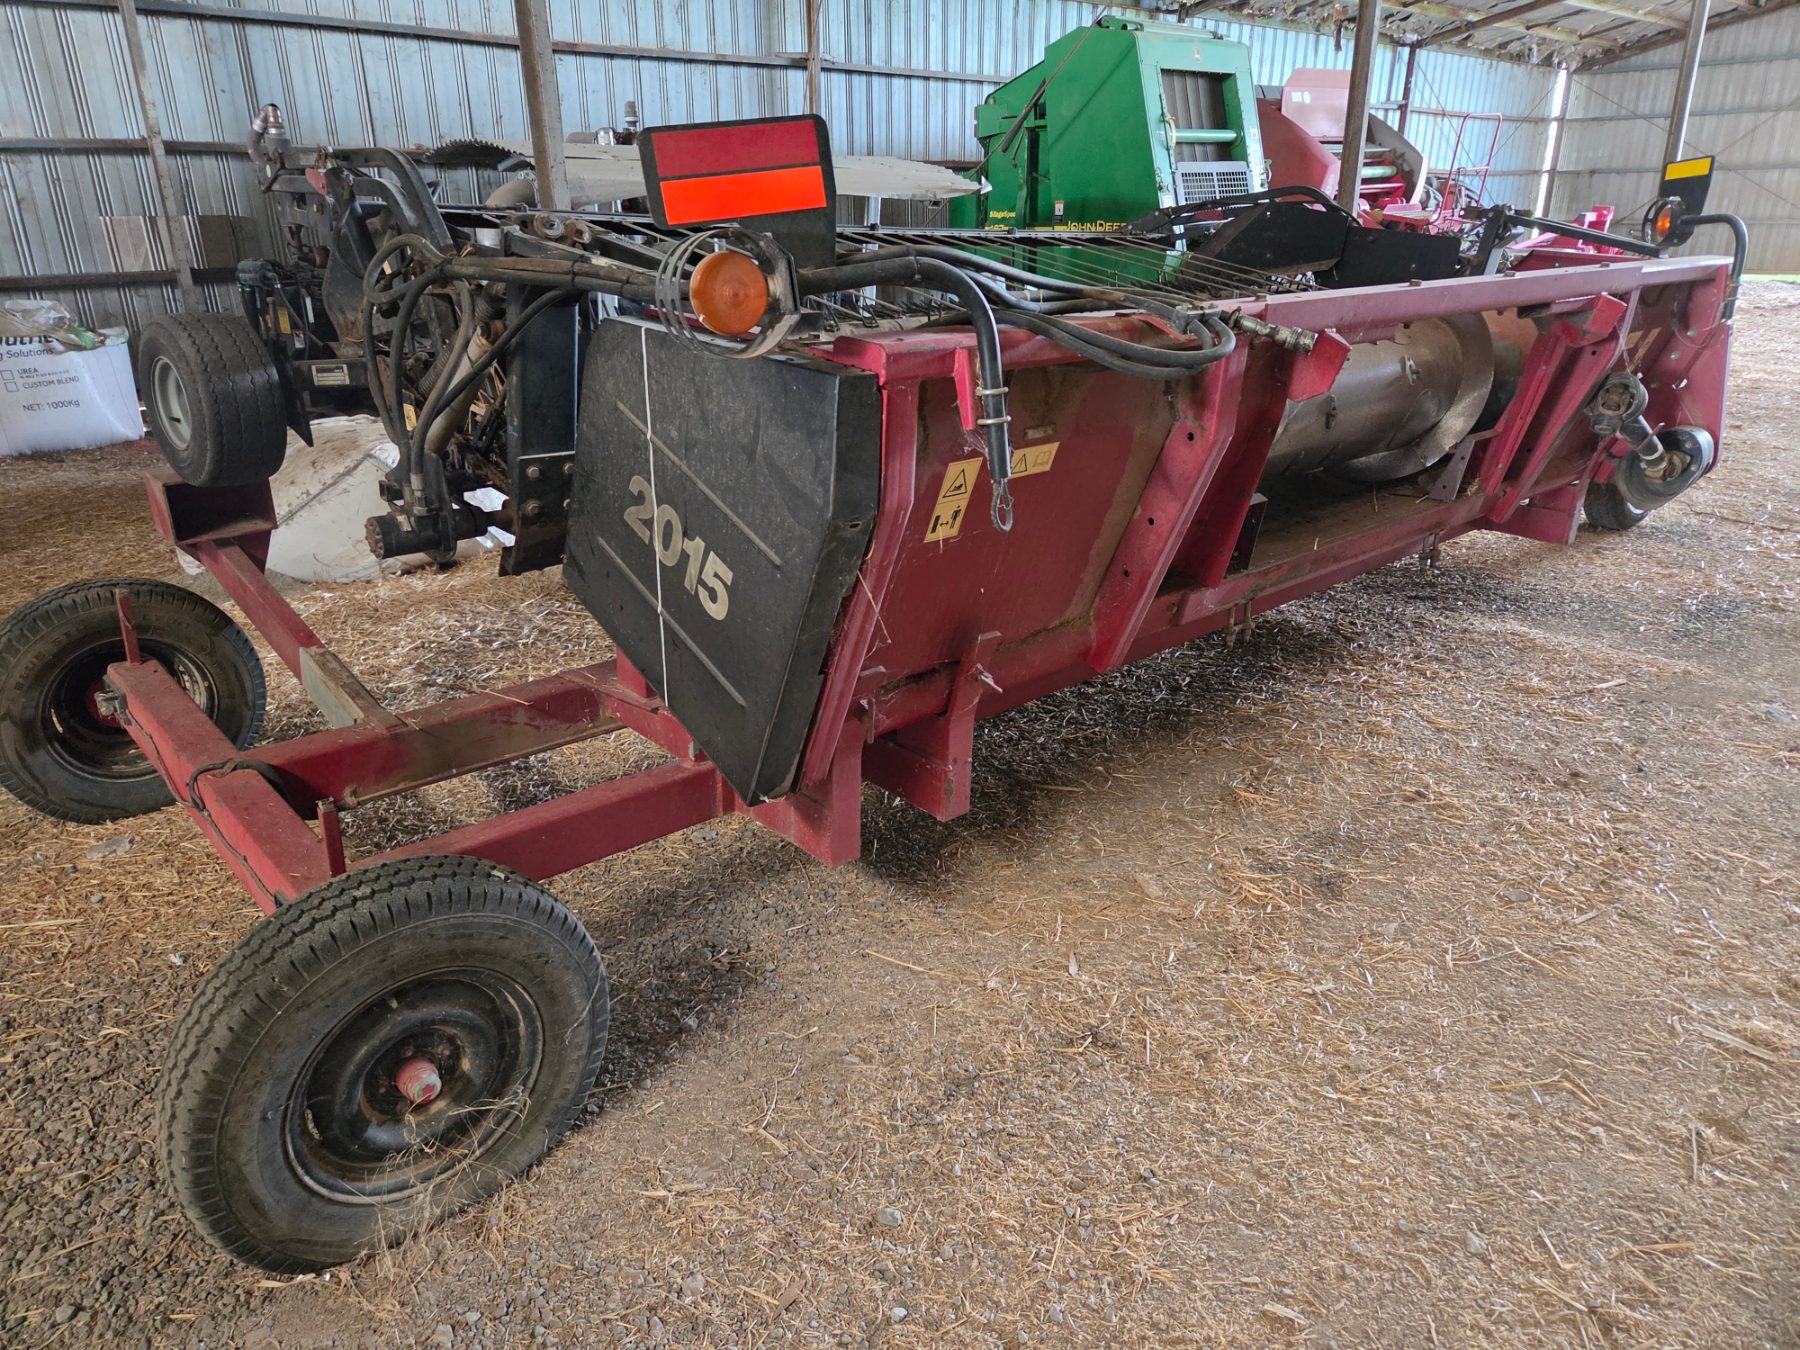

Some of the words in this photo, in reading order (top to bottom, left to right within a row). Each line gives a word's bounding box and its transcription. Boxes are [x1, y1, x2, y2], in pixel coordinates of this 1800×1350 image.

[1067, 221, 1096, 231] JOHN
[7, 348, 54, 359] Solutions
[17, 367, 39, 375] UREA
[23, 380, 56, 389] CUSTOM
[57, 375, 80, 385] BLEND
[22, 403, 44, 412] NET:
[47, 400, 80, 409] 1000Kg
[623, 475, 734, 621] 2015
